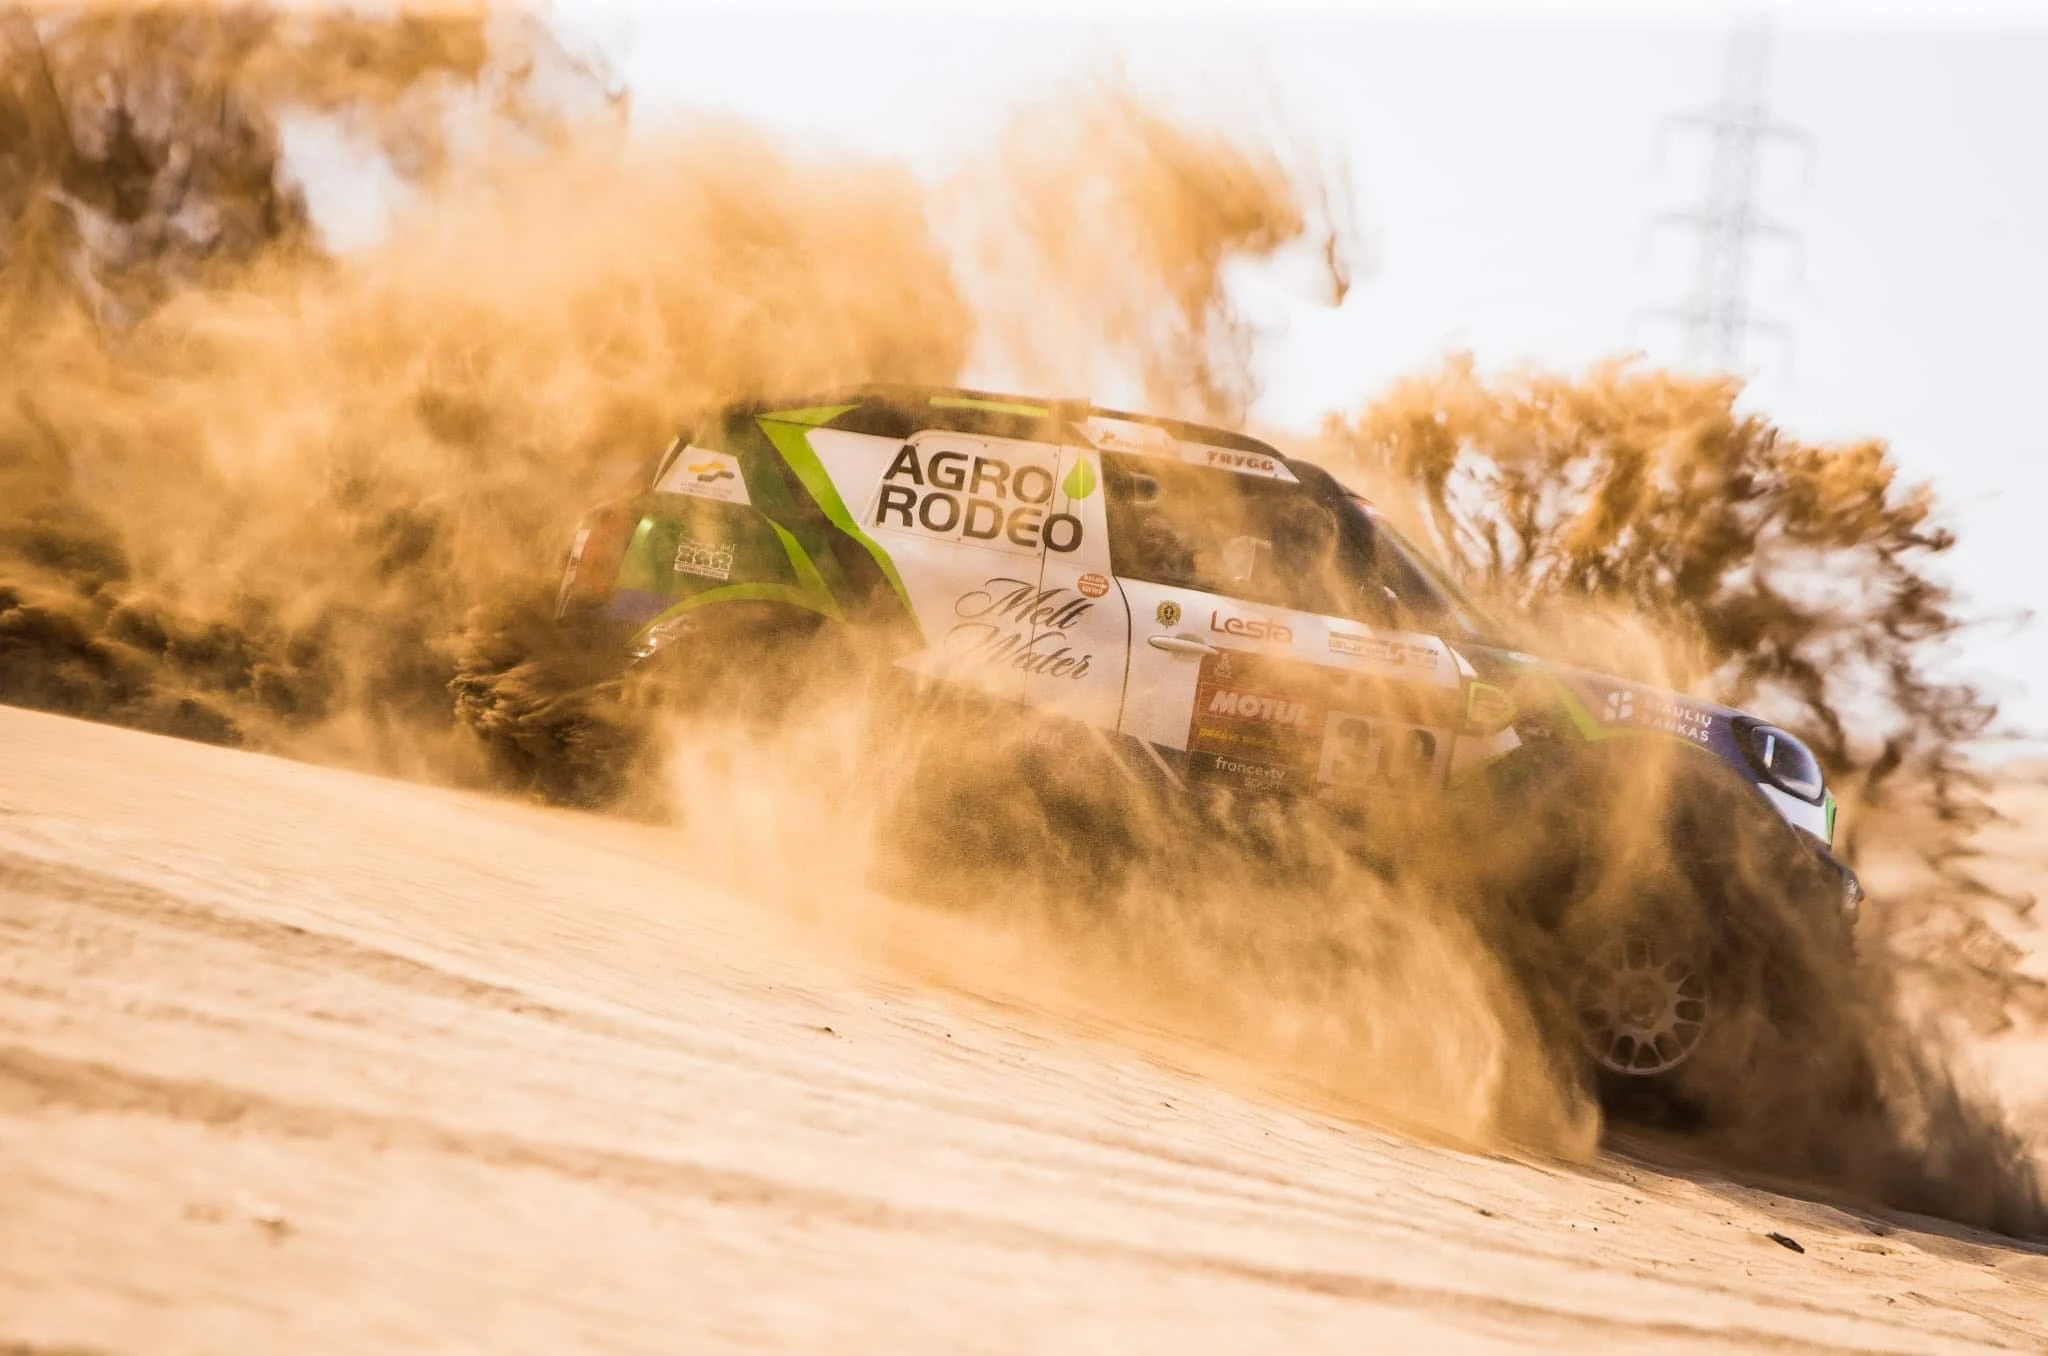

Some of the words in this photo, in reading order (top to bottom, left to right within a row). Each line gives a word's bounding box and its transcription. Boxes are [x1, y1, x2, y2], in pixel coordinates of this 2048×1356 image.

[883, 445, 1054, 504] AGRO
[1206, 451, 1275, 471] TRYGG
[876, 484, 1084, 553] RODEO
[955, 578, 1095, 629] Melt
[1210, 608, 1294, 643] Lesta
[944, 622, 1092, 680] Water
[1209, 690, 1311, 727] MOTUL
